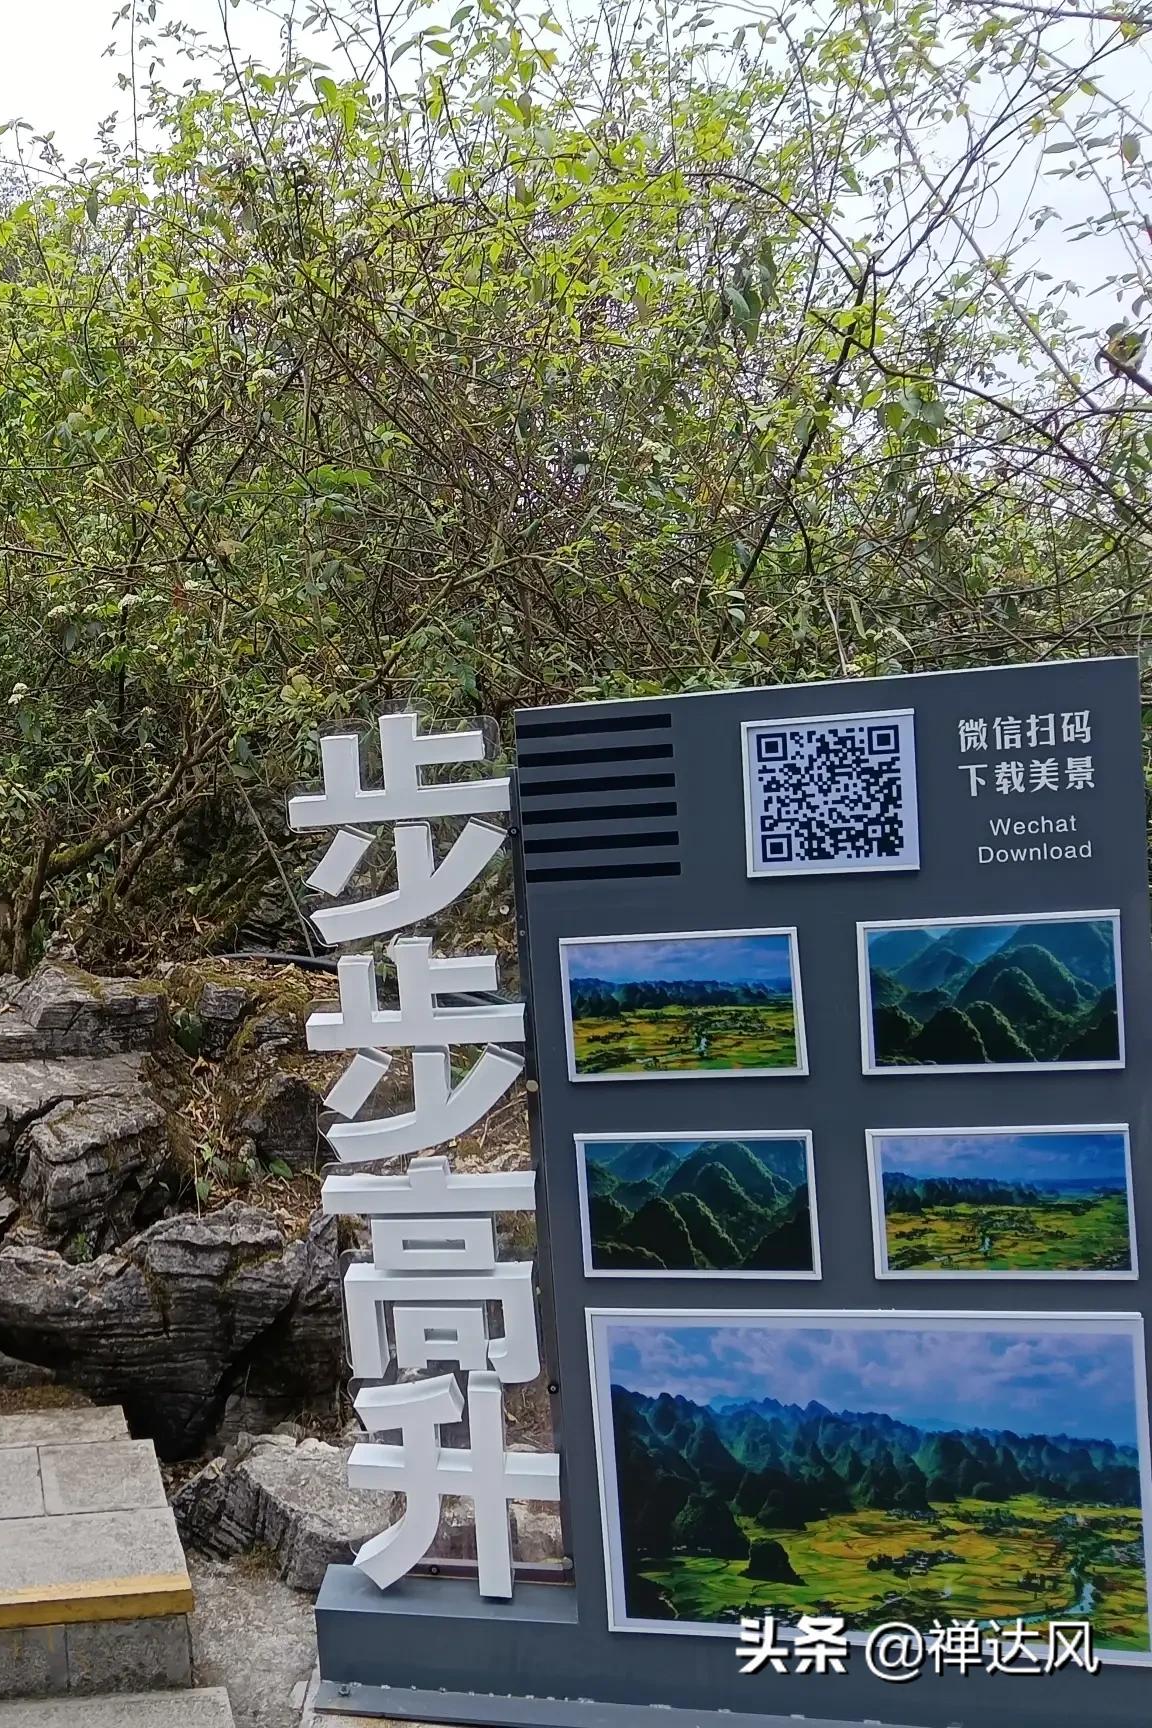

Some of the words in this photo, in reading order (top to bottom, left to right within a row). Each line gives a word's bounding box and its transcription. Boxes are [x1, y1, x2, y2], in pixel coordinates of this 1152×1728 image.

[958, 710, 1092, 753] 微信扫码
[958, 756, 1095, 797] 下载美景
[989, 815, 1077, 836] Wechat
[978, 841, 1092, 864] Download
[288, 713, 561, 1599] 步步高升
